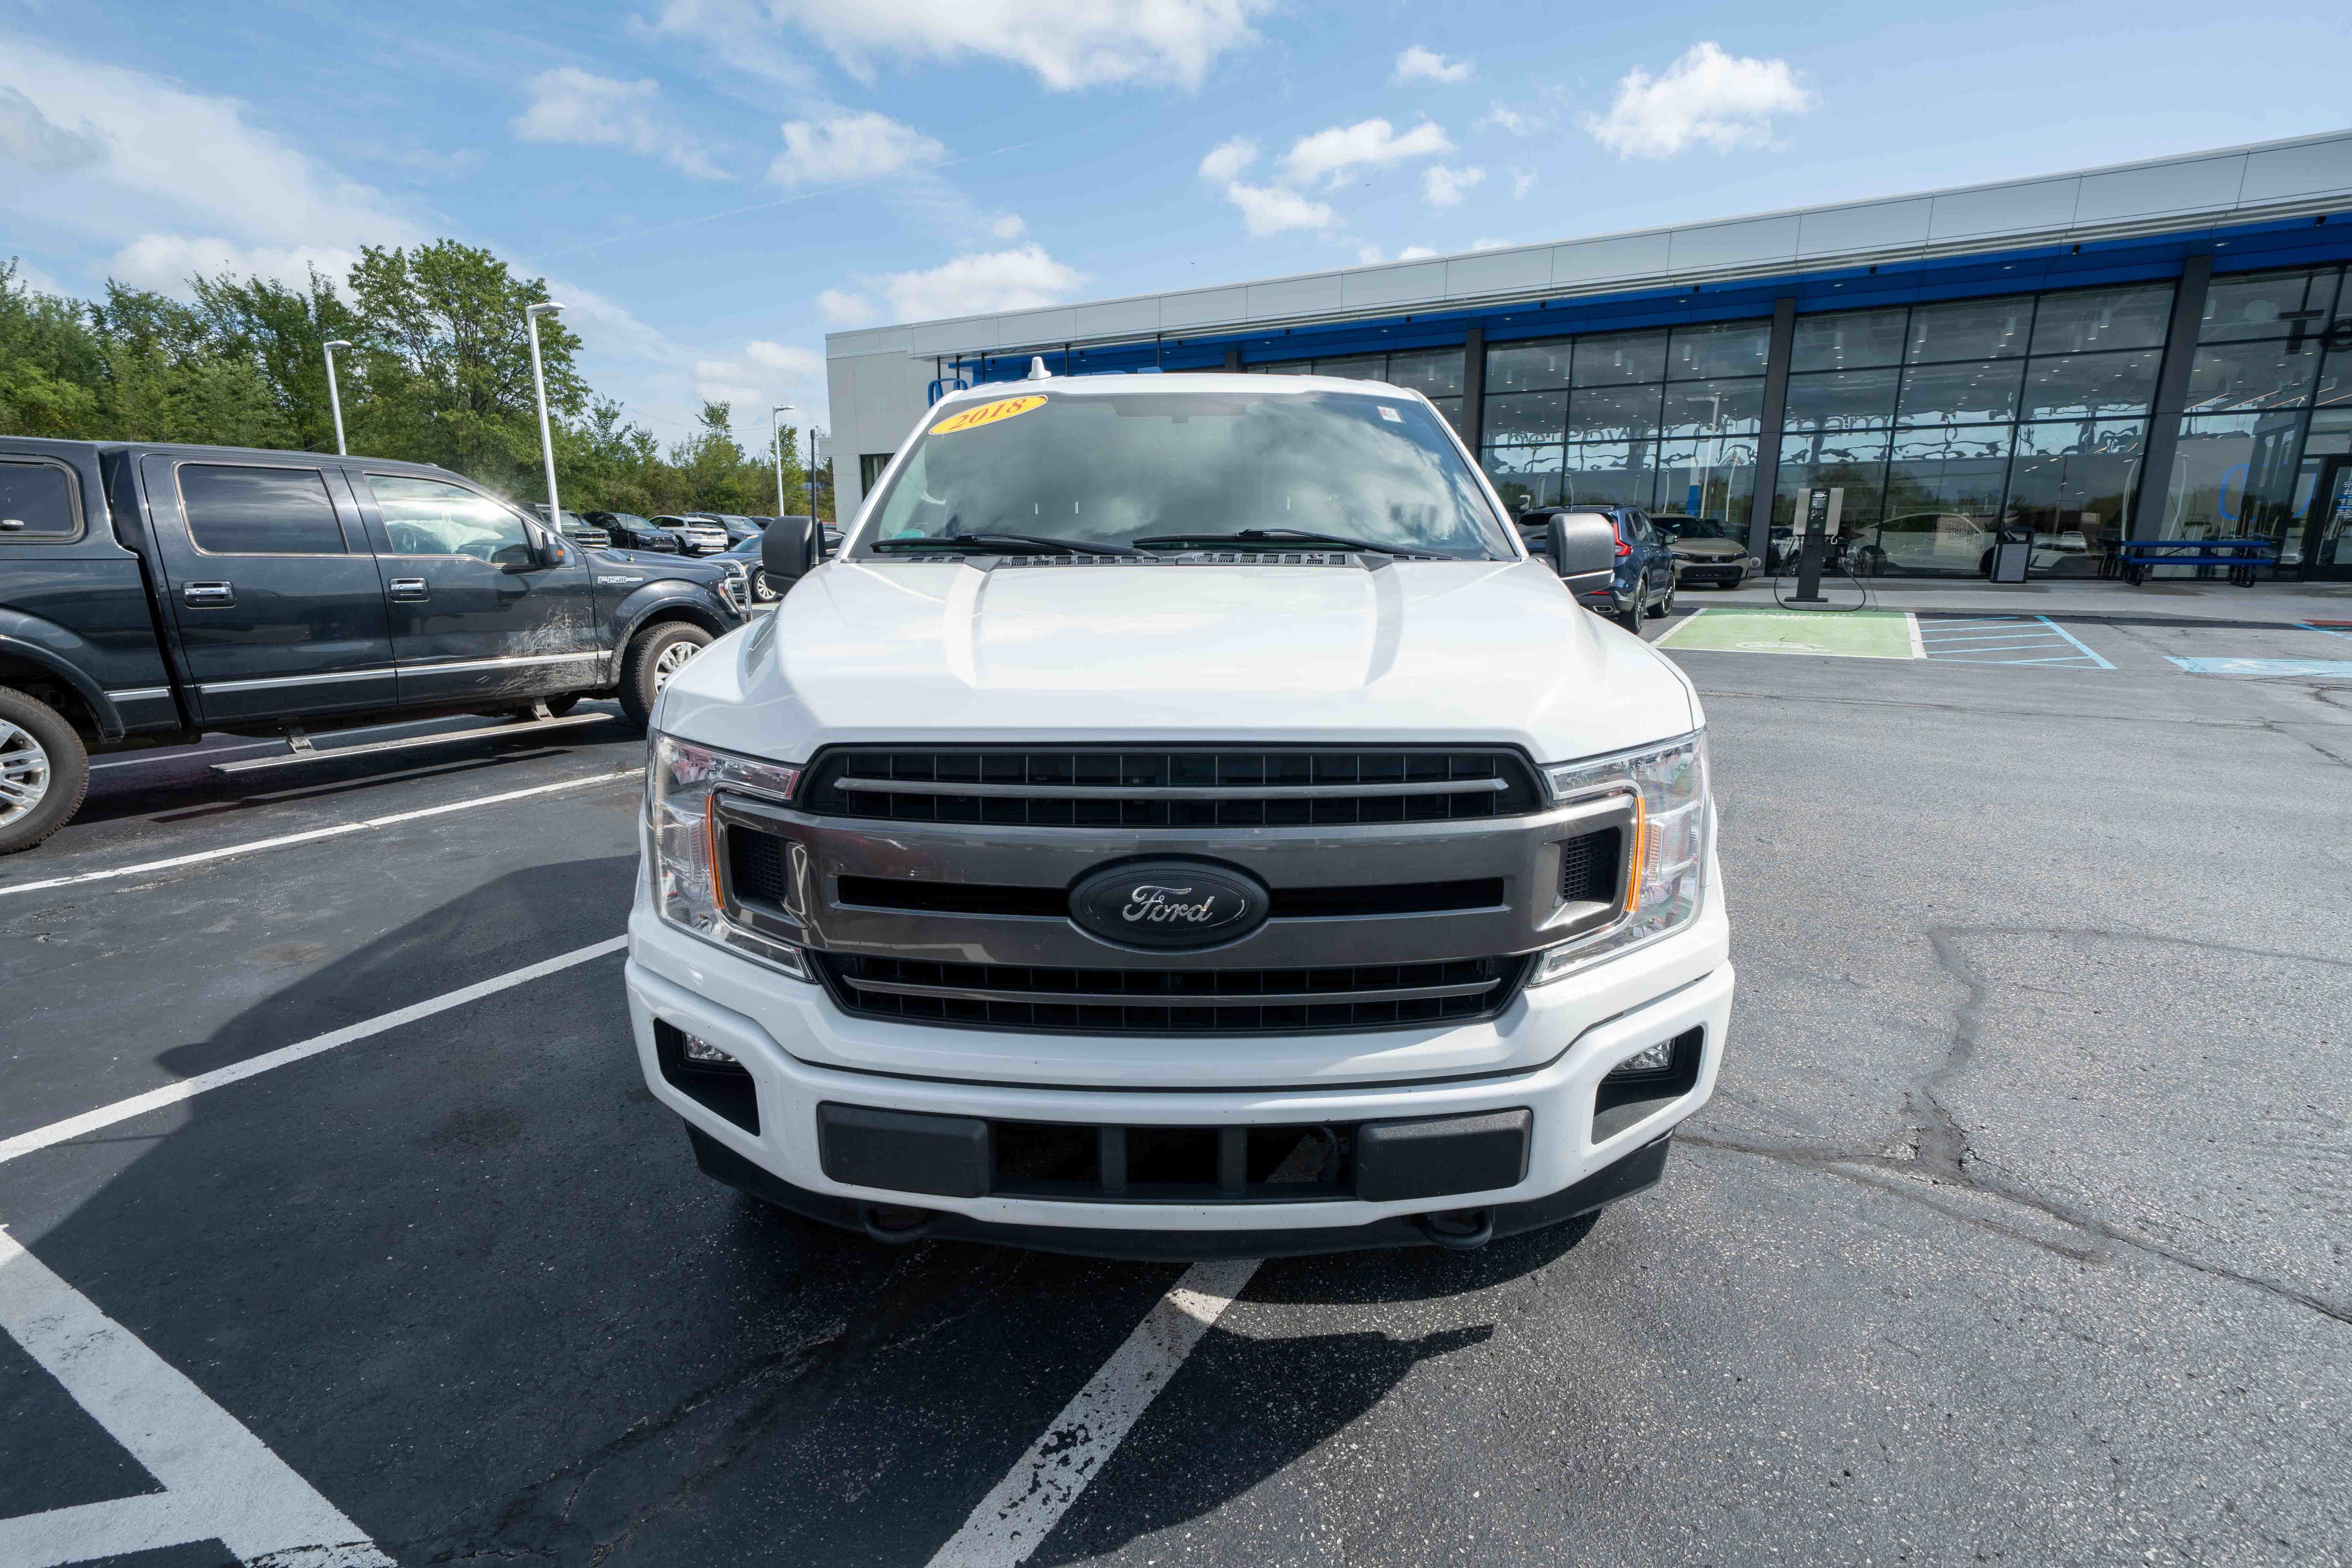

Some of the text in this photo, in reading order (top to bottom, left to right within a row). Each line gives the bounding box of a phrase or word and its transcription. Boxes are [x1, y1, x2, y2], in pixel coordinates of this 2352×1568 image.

[949, 398, 1027, 430] 2018
[1488, 428, 1546, 451] The
[1560, 424, 1679, 449] Power
[597, 576, 627, 584] F-150
[1122, 885, 1215, 922] Ford
